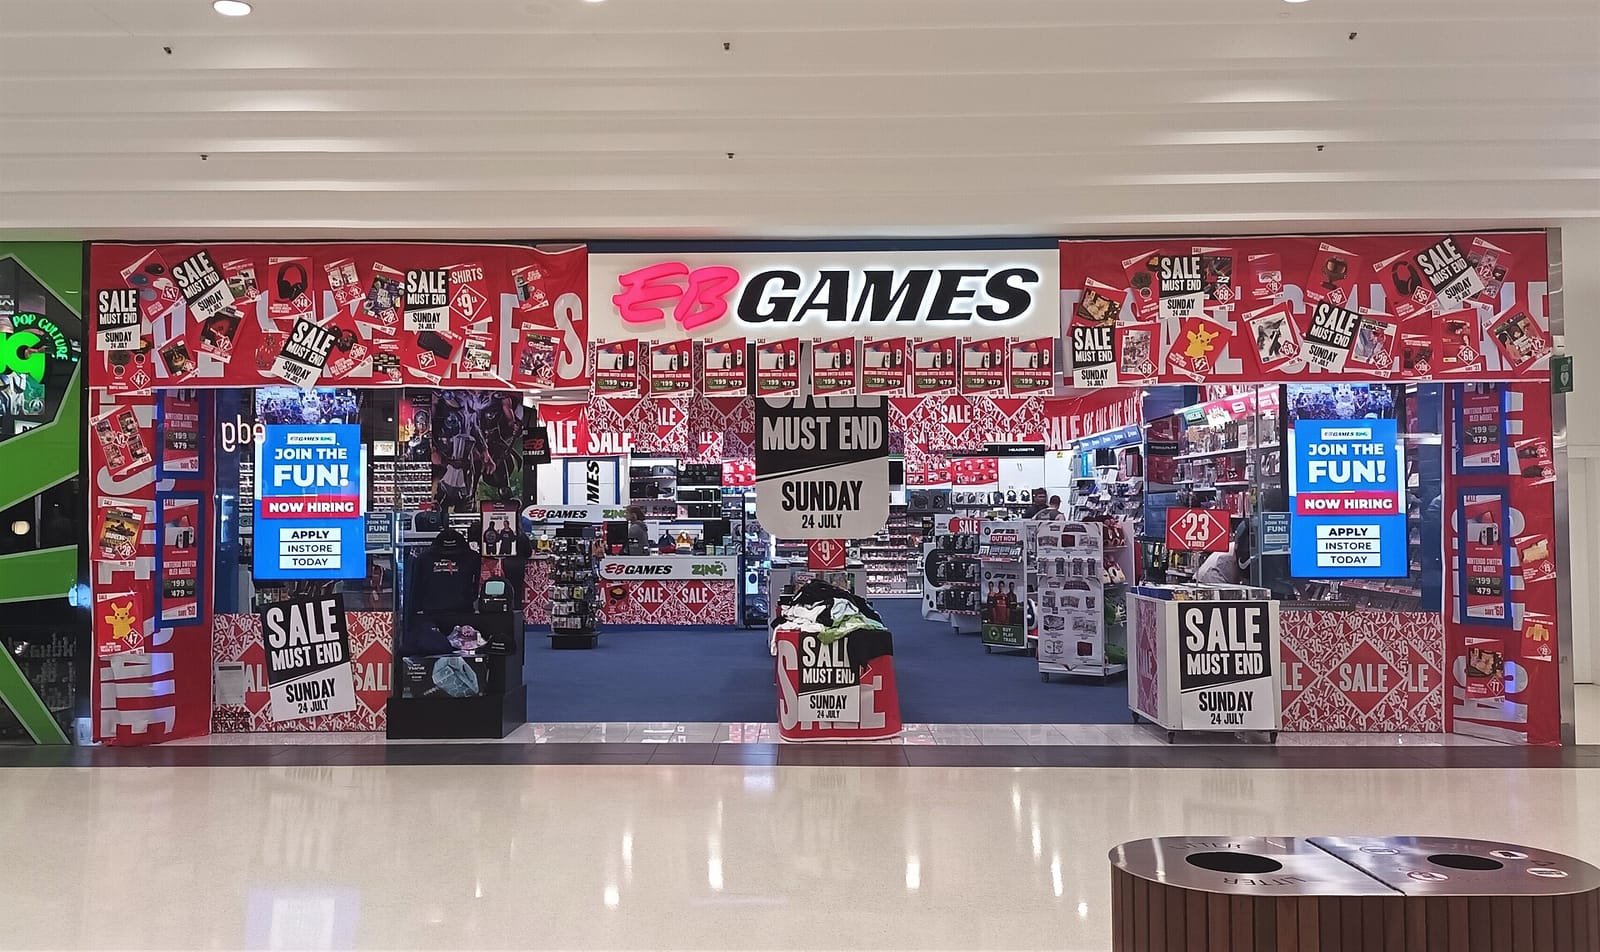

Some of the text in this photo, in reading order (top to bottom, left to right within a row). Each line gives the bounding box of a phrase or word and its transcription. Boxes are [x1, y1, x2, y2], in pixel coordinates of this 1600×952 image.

[1417, 238, 1461, 276] SALE
[173, 252, 214, 288] SALE
[1161, 257, 1200, 279] SALE
[1429, 257, 1467, 286] MUST END
[183, 272, 220, 299] MUST END
[407, 271, 446, 294] SALE
[1162, 280, 1202, 290] MUST END
[1445, 276, 1472, 299] SUNDAY
[99, 290, 137, 312] SALE
[198, 290, 224, 312] SUNDAY
[407, 294, 447, 304] MUST END
[612, 262, 1040, 330] EB GAMES
[1168, 299, 1195, 310] SUNDAY
[100, 313, 138, 325] MUST END
[412, 312, 440, 322] SUNDAY
[1315, 304, 1358, 336] SALE
[12, 314, 68, 360] POP CULTURE
[105, 332, 132, 342] SUNDAY
[292, 322, 336, 357] SALE
[1074, 328, 1112, 350] SALE
[1310, 324, 1350, 348] MUST END
[286, 341, 310, 360] MUST
[309, 352, 325, 368] END
[1075, 350, 1113, 362] MUST END
[1308, 344, 1338, 363] SUNDAY
[282, 361, 311, 380] SUNDAY
[1081, 370, 1108, 380] SUNDAY
[940, 404, 972, 424] SALE
[762, 416, 882, 450] MUST END
[274, 448, 348, 461] JOIN THE
[1308, 444, 1384, 456] JOIN THE
[274, 464, 349, 487] FUN!
[1308, 460, 1386, 484] FUN!
[782, 480, 863, 511] SUNDAY
[1304, 499, 1393, 510] NOW HIRING
[269, 502, 354, 513] NOW HIRING
[528, 508, 589, 520] EB GAMES
[802, 514, 842, 529] 24 JULY
[958, 520, 978, 534] SALE
[1181, 513, 1210, 541] $23
[1267, 526, 1287, 534] FUN!
[291, 531, 330, 540] APPLY
[1328, 528, 1368, 537] APPLY
[288, 545, 332, 553] INSTORE
[1325, 542, 1372, 550] INSTORE
[292, 558, 328, 566] TODAY
[604, 563, 673, 576] EB GAMES
[1330, 556, 1368, 564] TODAY
[637, 586, 664, 602] SALE
[682, 586, 708, 602] SALE
[266, 600, 340, 648] SALE
[1185, 608, 1262, 652] SALE
[272, 642, 342, 671] MUST END
[1186, 653, 1264, 675] MUST END
[802, 668, 833, 684] MUST
[1339, 664, 1389, 693] SALE
[286, 678, 336, 703] SUNDAY
[298, 699, 329, 714] 24 JULY
[810, 695, 848, 710] SUNDAY
[1198, 692, 1254, 712] SUNDAY
[816, 710, 840, 719] 24 JULY
[1210, 713, 1244, 725] 24 JULY
